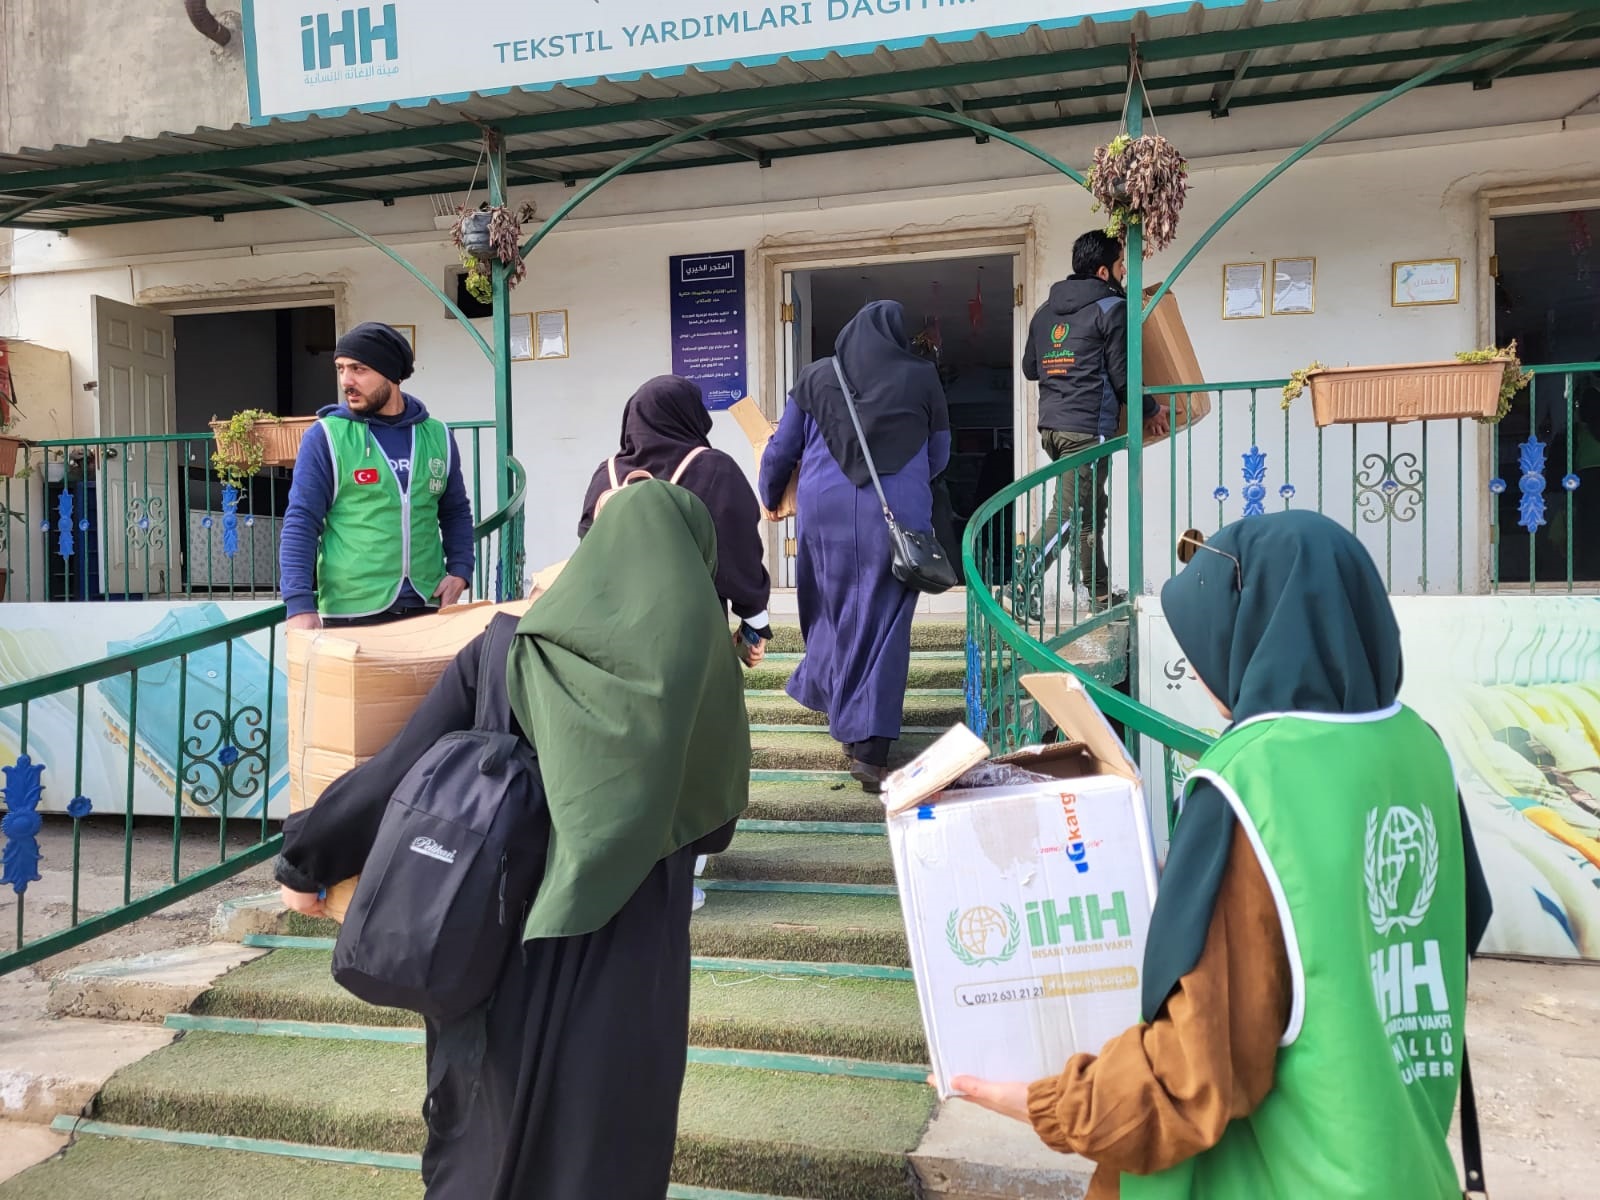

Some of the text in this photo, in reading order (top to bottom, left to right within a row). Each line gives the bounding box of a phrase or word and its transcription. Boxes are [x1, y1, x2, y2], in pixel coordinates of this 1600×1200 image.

[622, 2, 812, 47] YARDIMLARI
[685, 262, 730, 275] المتجر الخيري
[1065, 944, 1104, 956] YARDIM
[1104, 940, 1133, 951] VAKFI
[974, 986, 1044, 1004] 0212 631 21 21
[1418, 1013, 1453, 1030] VAKFI
